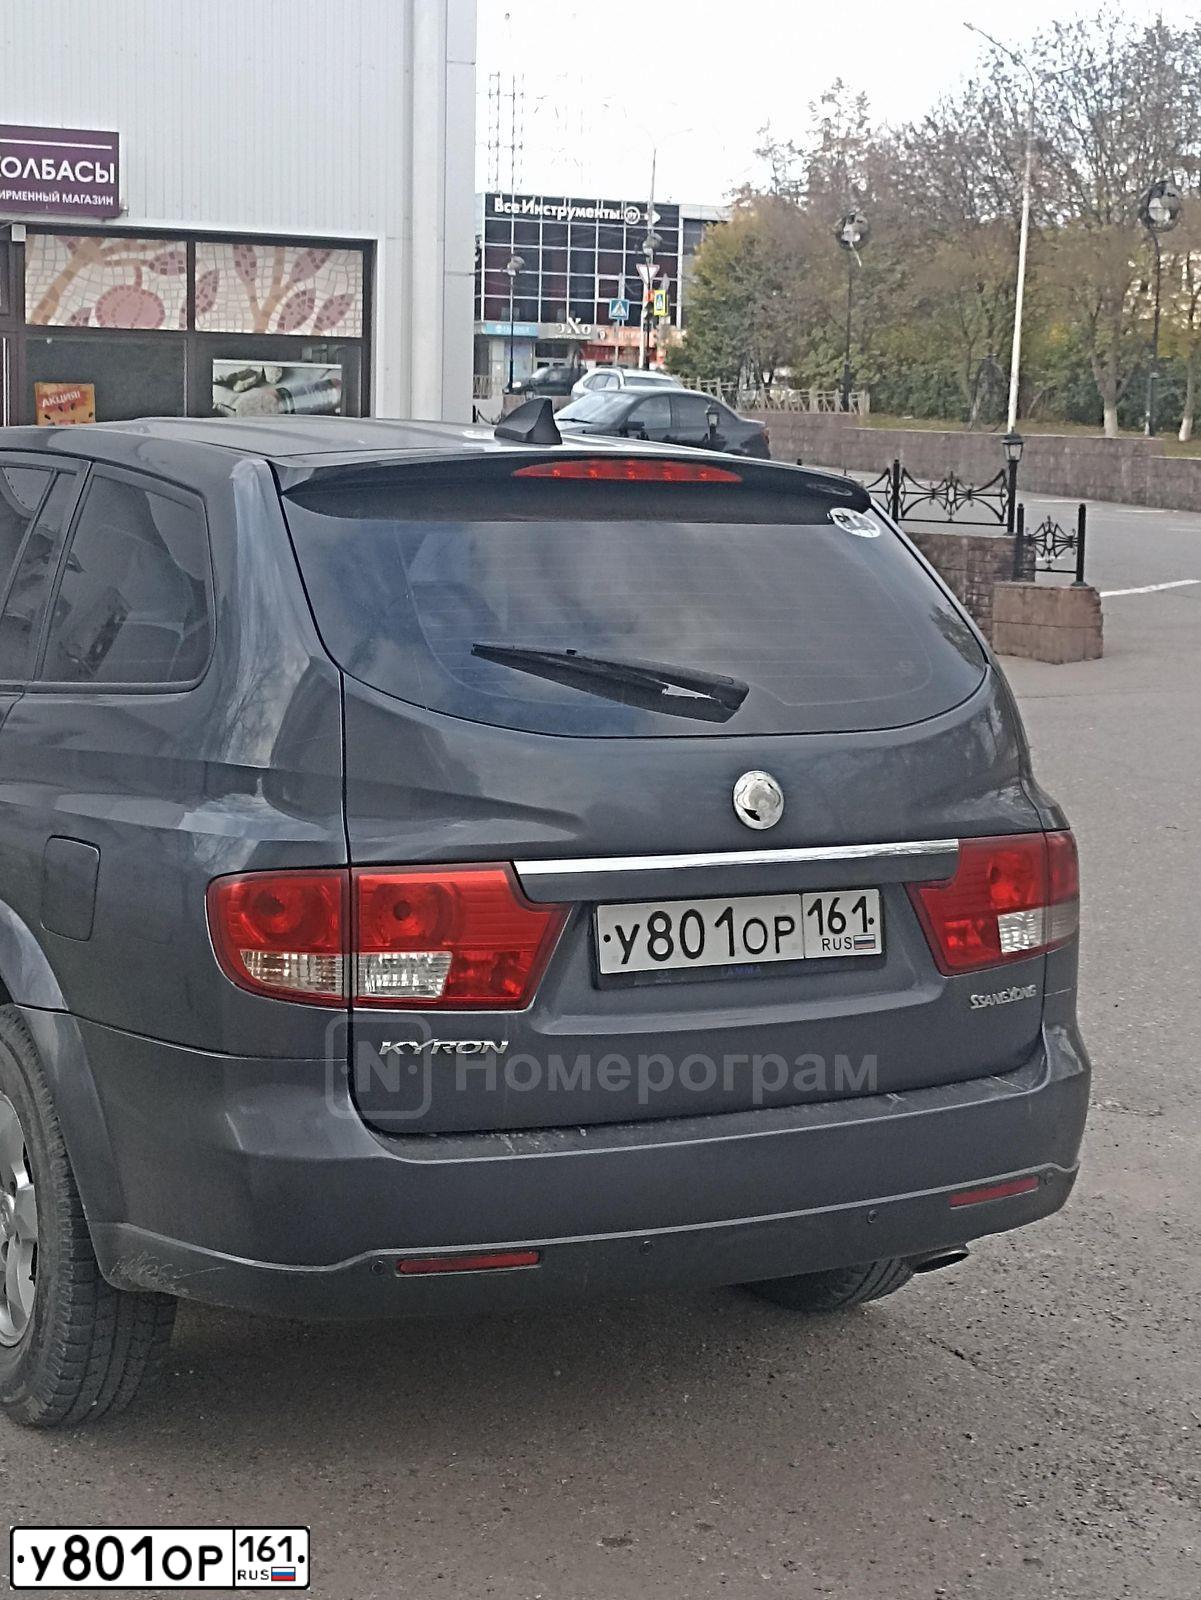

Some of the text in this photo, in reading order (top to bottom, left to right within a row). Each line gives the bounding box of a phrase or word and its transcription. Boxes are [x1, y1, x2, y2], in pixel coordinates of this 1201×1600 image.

[0, 155, 115, 184] ОЛБАСЫ
[62, 193, 114, 206] МАГАЗИН
[614, 895, 869, 965] У801ОР 161
[821, 937, 853, 951] RUS
[378, 1038, 509, 1055] KYRON
